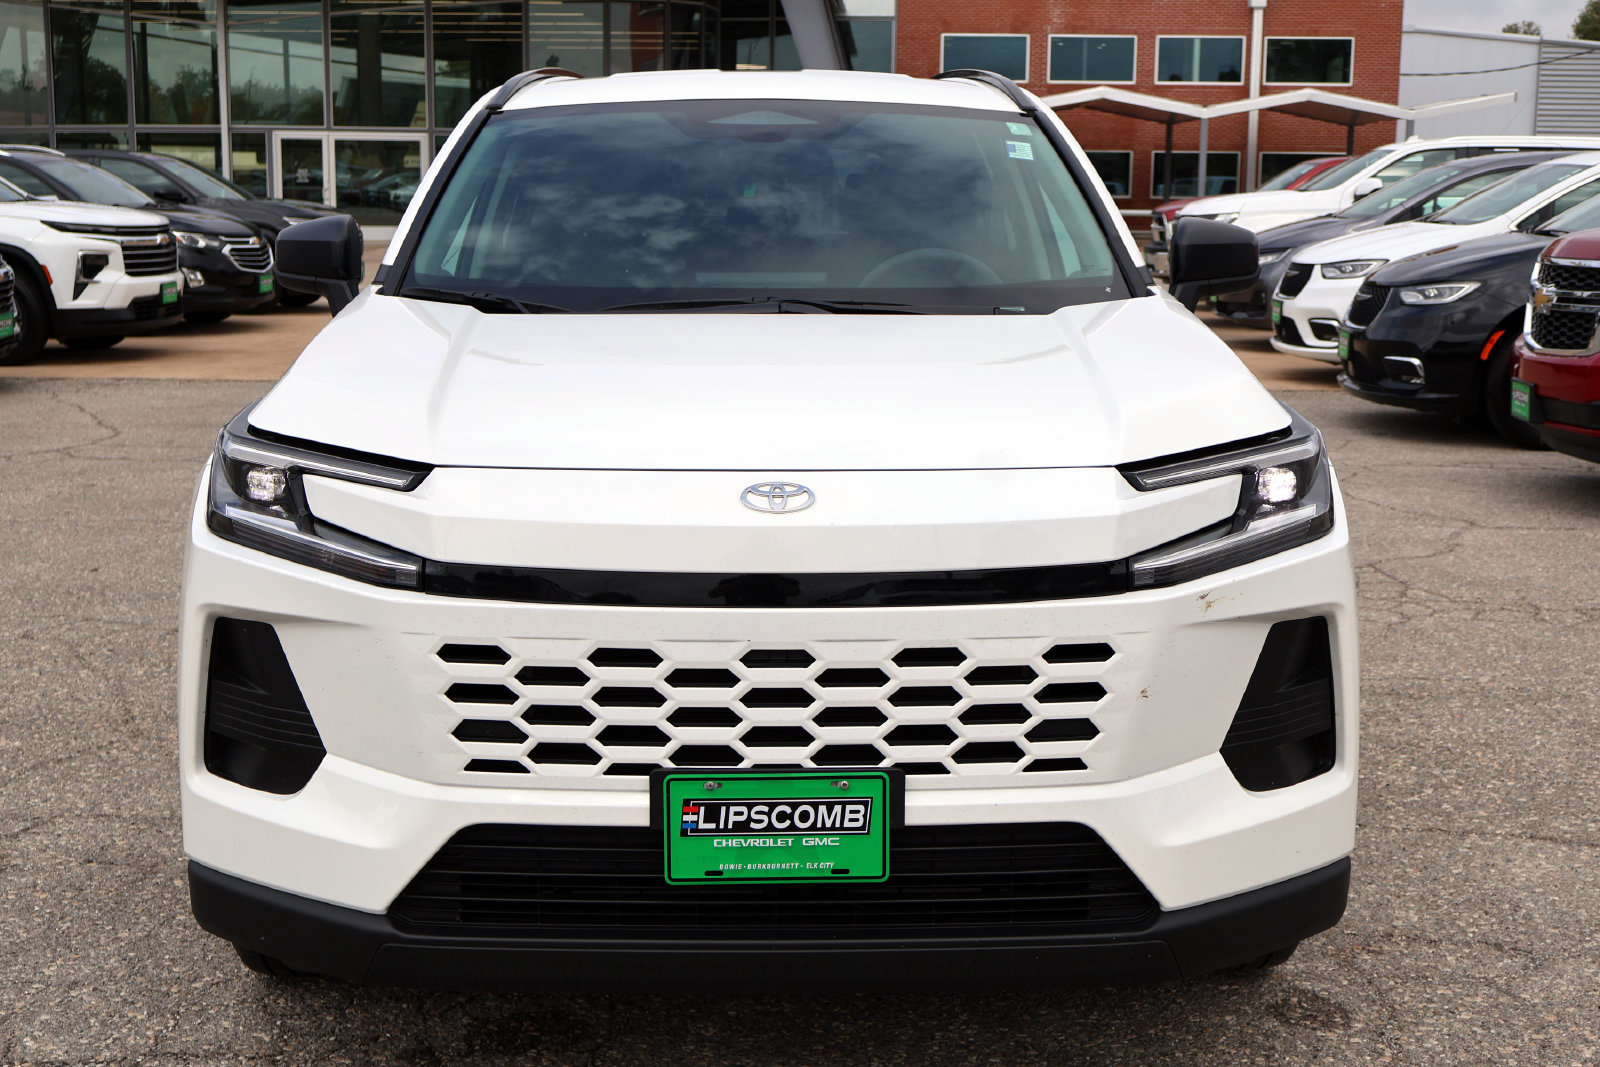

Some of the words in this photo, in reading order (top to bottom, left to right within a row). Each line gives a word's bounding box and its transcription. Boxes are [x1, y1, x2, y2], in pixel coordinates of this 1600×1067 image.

[698, 805, 865, 829] LIPSCOMB
[713, 838, 794, 847] CHEVROLET
[802, 837, 840, 846] GMC
